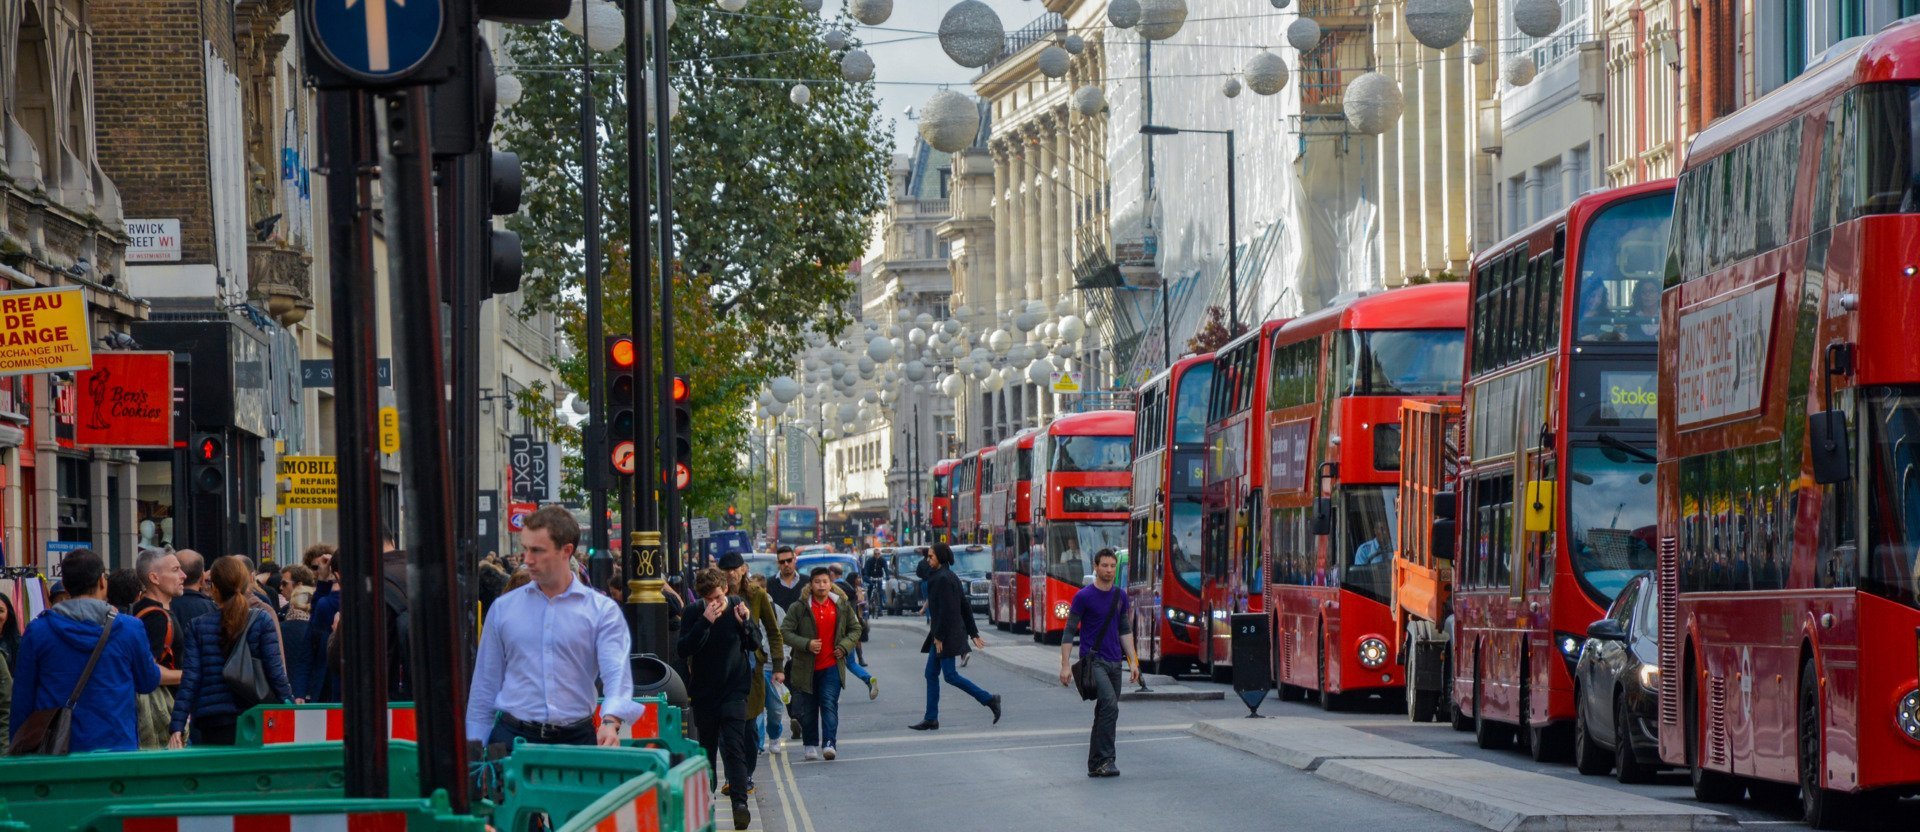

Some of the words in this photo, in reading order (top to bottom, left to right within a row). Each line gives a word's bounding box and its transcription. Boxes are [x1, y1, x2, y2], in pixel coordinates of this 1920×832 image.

[124, 223, 164, 235] RWICK
[130, 236, 155, 247] REET
[158, 236, 174, 247] W1
[136, 252, 171, 260] WESTMINSTER
[1, 293, 63, 314] REAU
[5, 312, 36, 331] DE
[0, 325, 69, 347] ANGE
[0, 346, 50, 359] XCHANGE
[112, 385, 149, 404] Ben's
[1611, 385, 1657, 405] Stoke
[112, 402, 161, 419] Cookies
[513, 437, 531, 493] next
[1070, 494, 1097, 506] King's
[1100, 494, 1128, 503] Cross
